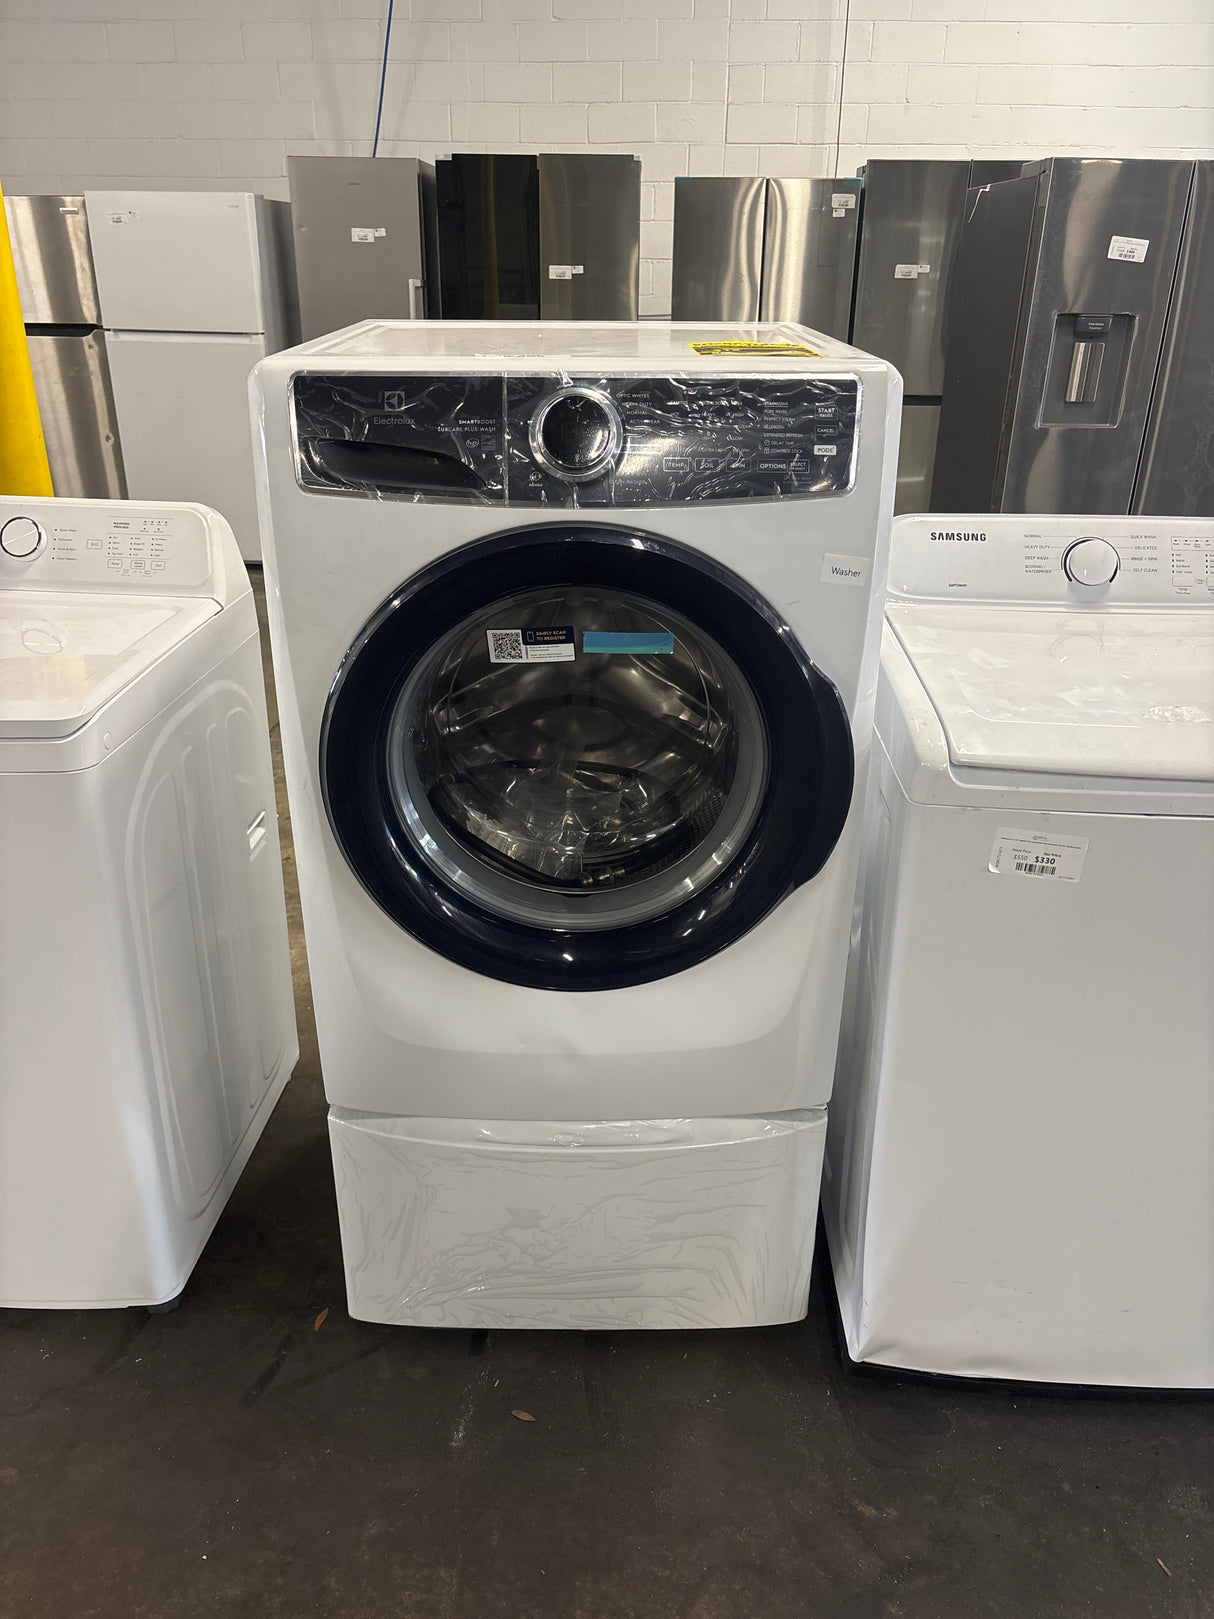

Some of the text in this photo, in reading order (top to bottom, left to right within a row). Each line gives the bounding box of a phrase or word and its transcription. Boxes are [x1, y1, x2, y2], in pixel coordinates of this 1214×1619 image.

[373, 416, 416, 426] Electrolux
[930, 532, 987, 542] SAMSUNG
[831, 566, 862, 578] Washer
[1034, 855, 1056, 865] $330
